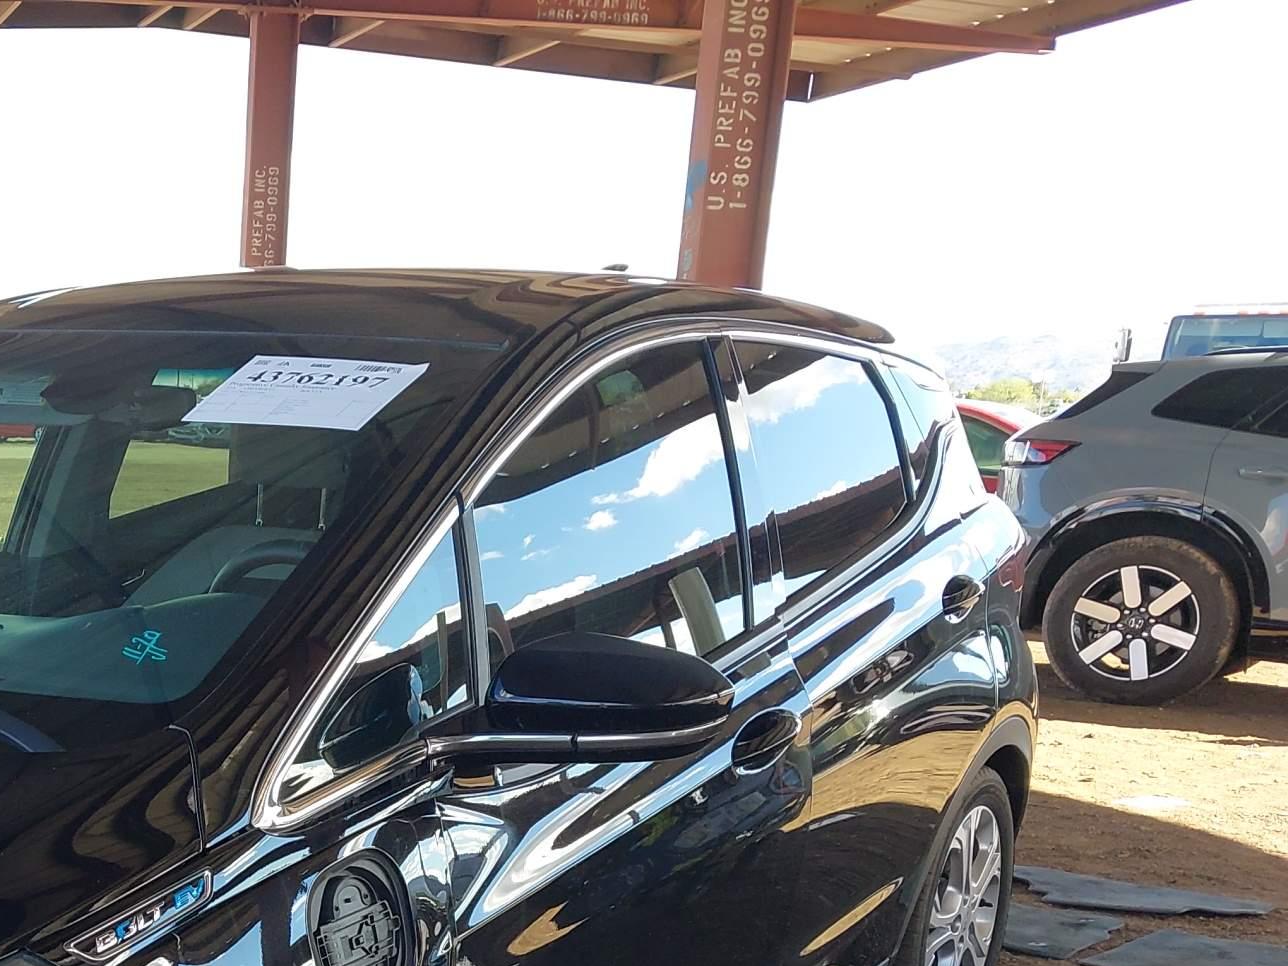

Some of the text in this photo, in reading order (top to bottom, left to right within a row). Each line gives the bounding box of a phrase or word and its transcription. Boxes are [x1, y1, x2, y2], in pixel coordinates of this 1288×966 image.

[536, 8, 649, 25] 1-866-799-0969
[714, 47, 742, 148] PREFAB
[728, 0, 771, 209] 1-866-799-096
[251, 164, 267, 256] PREFAB INC.
[706, 163, 729, 211] U.S.
[246, 369, 391, 389] 43762197
[95, 878, 205, 954] BOLT EV
